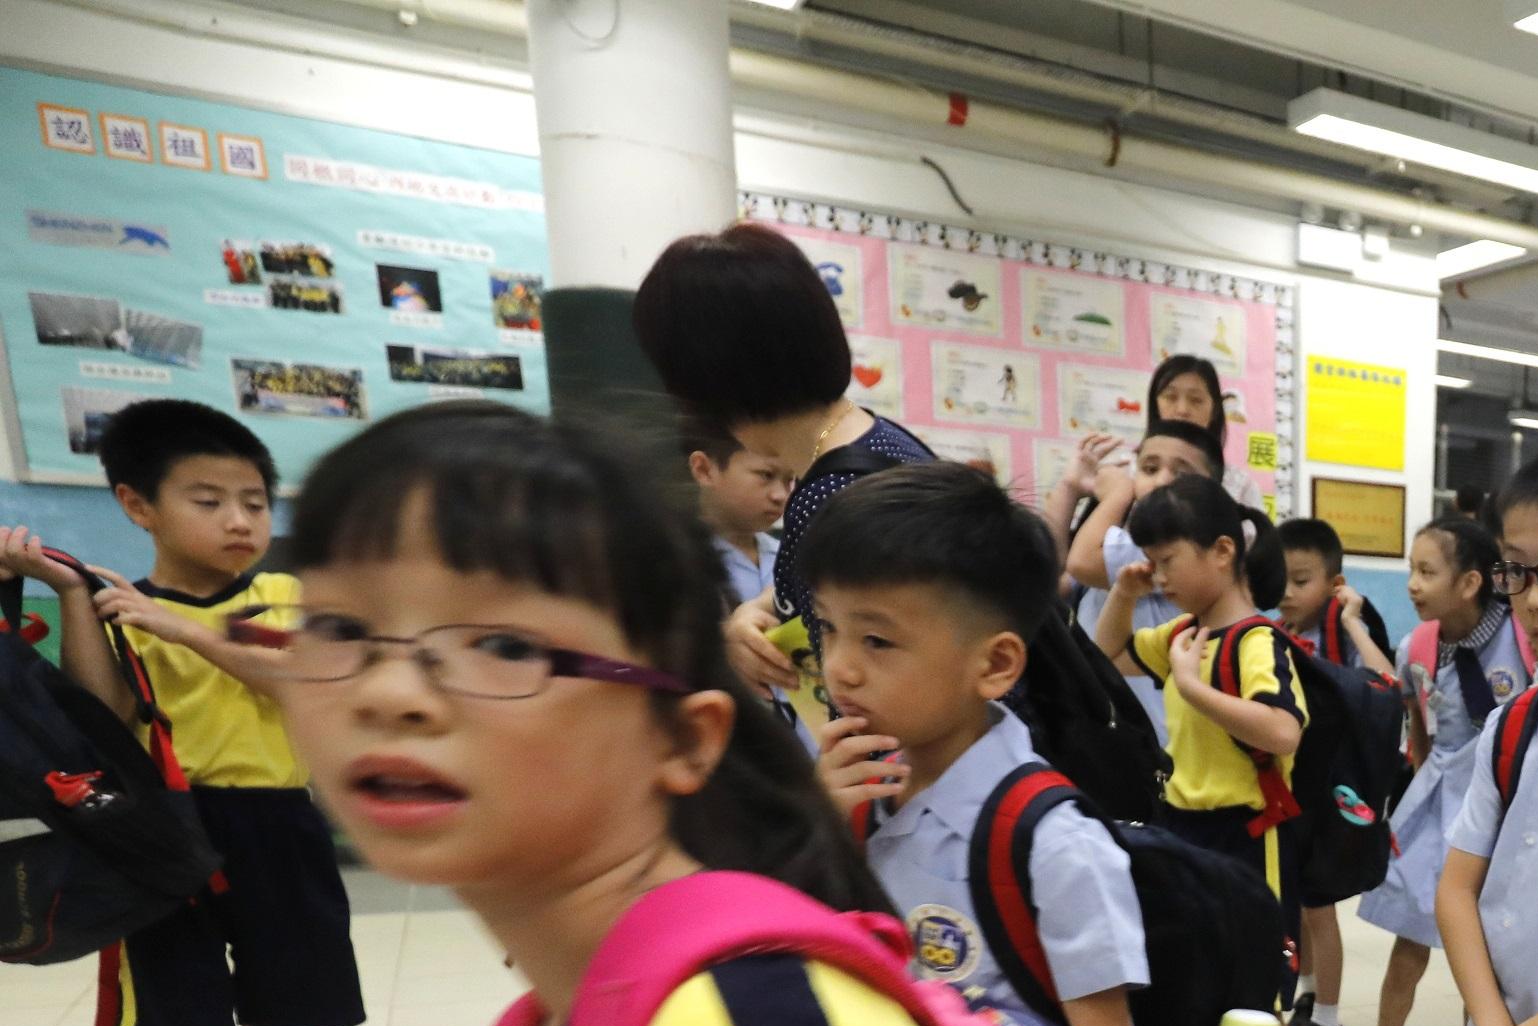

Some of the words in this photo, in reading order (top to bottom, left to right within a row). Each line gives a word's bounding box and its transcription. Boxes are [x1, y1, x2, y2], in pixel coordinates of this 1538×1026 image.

[51, 115, 257, 171] 認識祖國
[1248, 435, 1276, 468] 展
